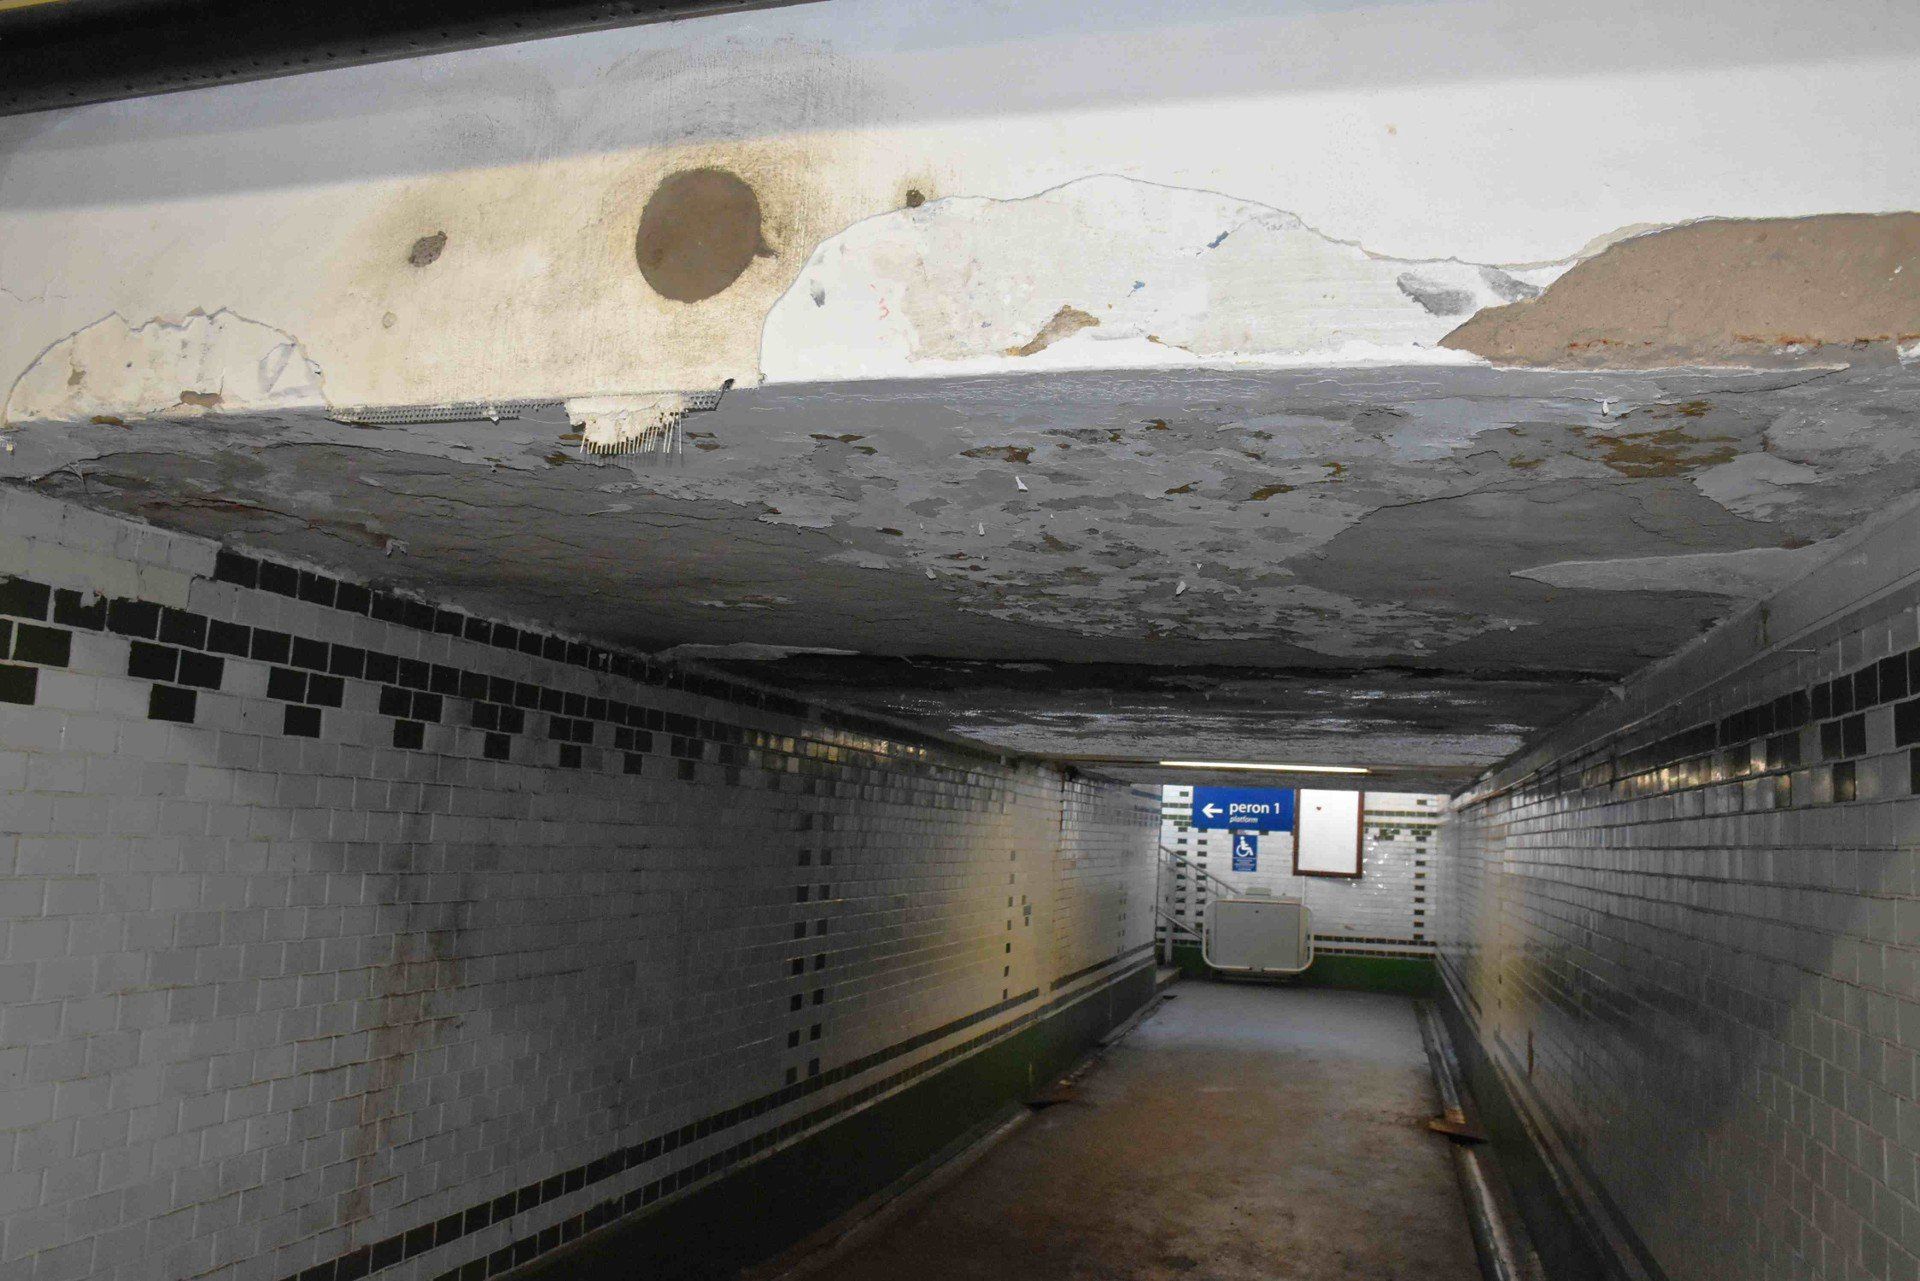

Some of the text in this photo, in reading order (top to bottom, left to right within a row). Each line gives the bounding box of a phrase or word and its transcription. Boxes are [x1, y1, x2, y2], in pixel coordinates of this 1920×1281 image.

[1229, 803, 1280, 815] peron 1
[1229, 815, 1258, 823] platform
